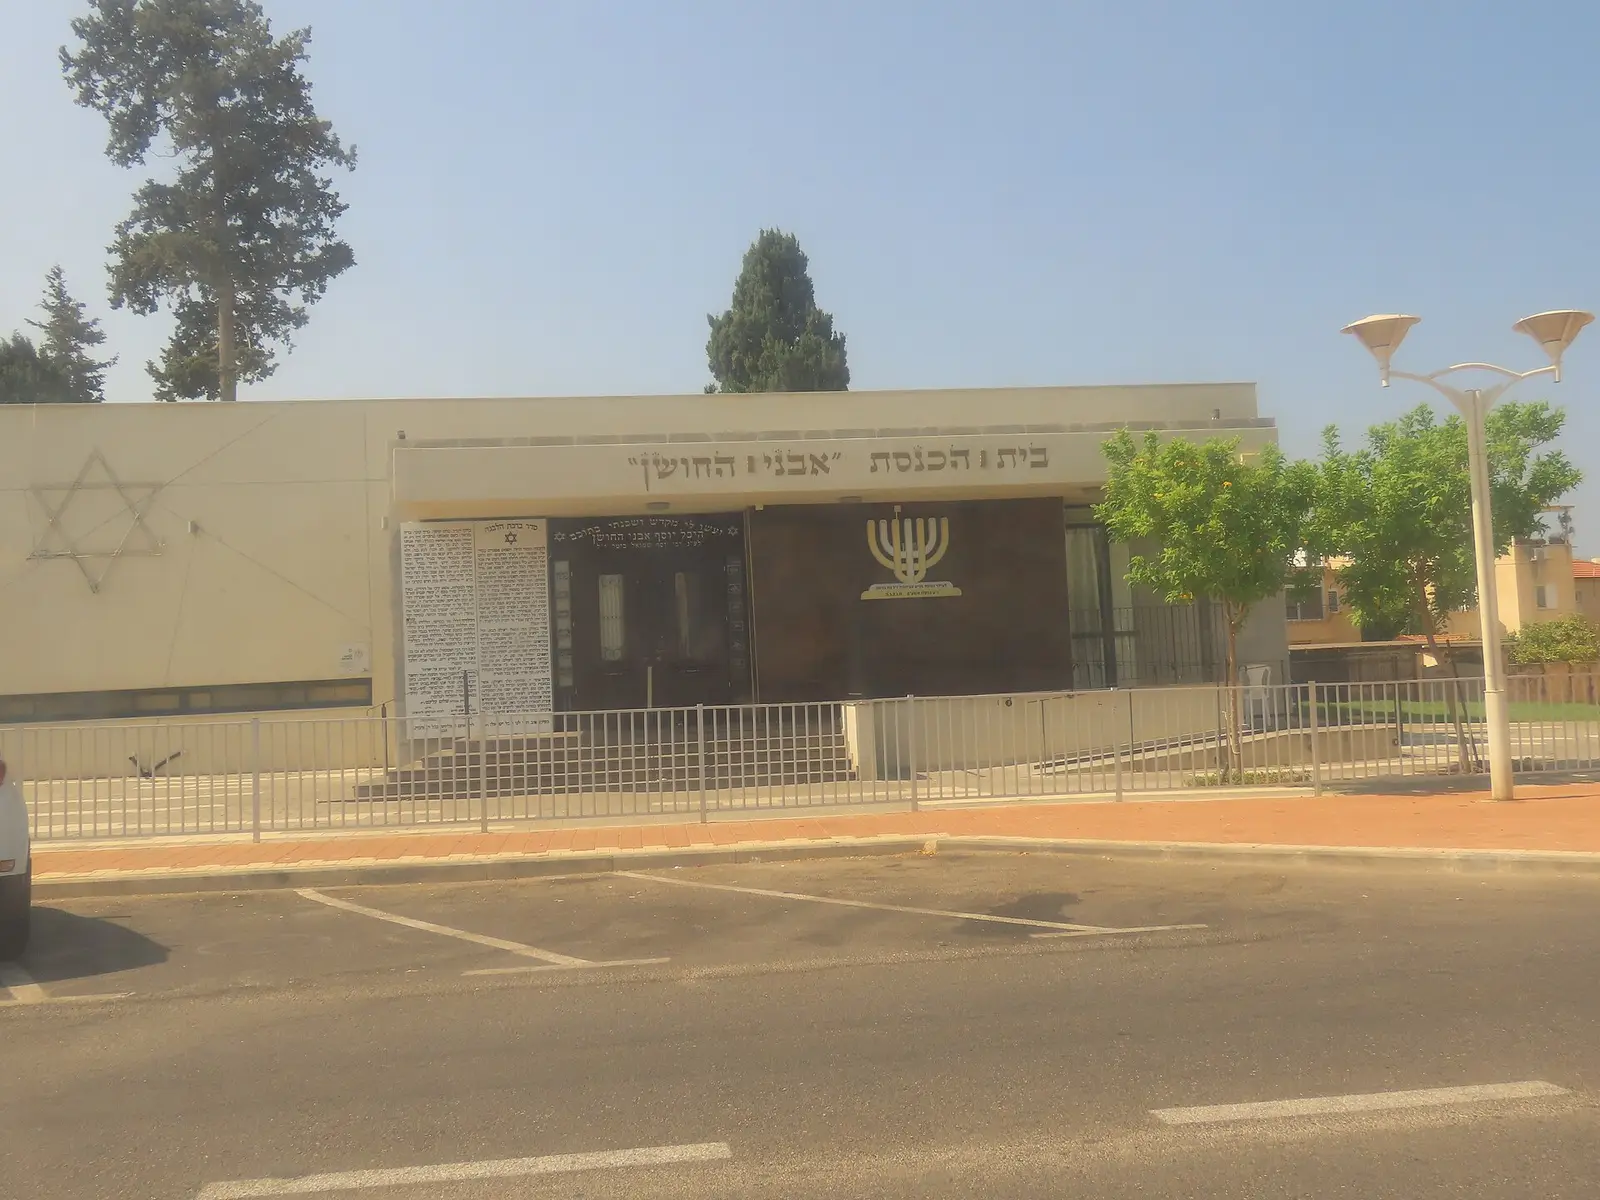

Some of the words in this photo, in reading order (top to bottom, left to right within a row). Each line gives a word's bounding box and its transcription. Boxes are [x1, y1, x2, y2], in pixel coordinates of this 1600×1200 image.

[870, 443, 971, 472] הכנסת
[997, 442, 1049, 469] בית
[608, 519, 644, 529] ושכנתי
[649, 518, 680, 528] מקדש
[569, 525, 601, 541] בתוכם
[592, 532, 624, 545] החושן
[628, 531, 651, 541] אבני
[654, 531, 676, 542] יוסף
[680, 528, 705, 539] היכל
